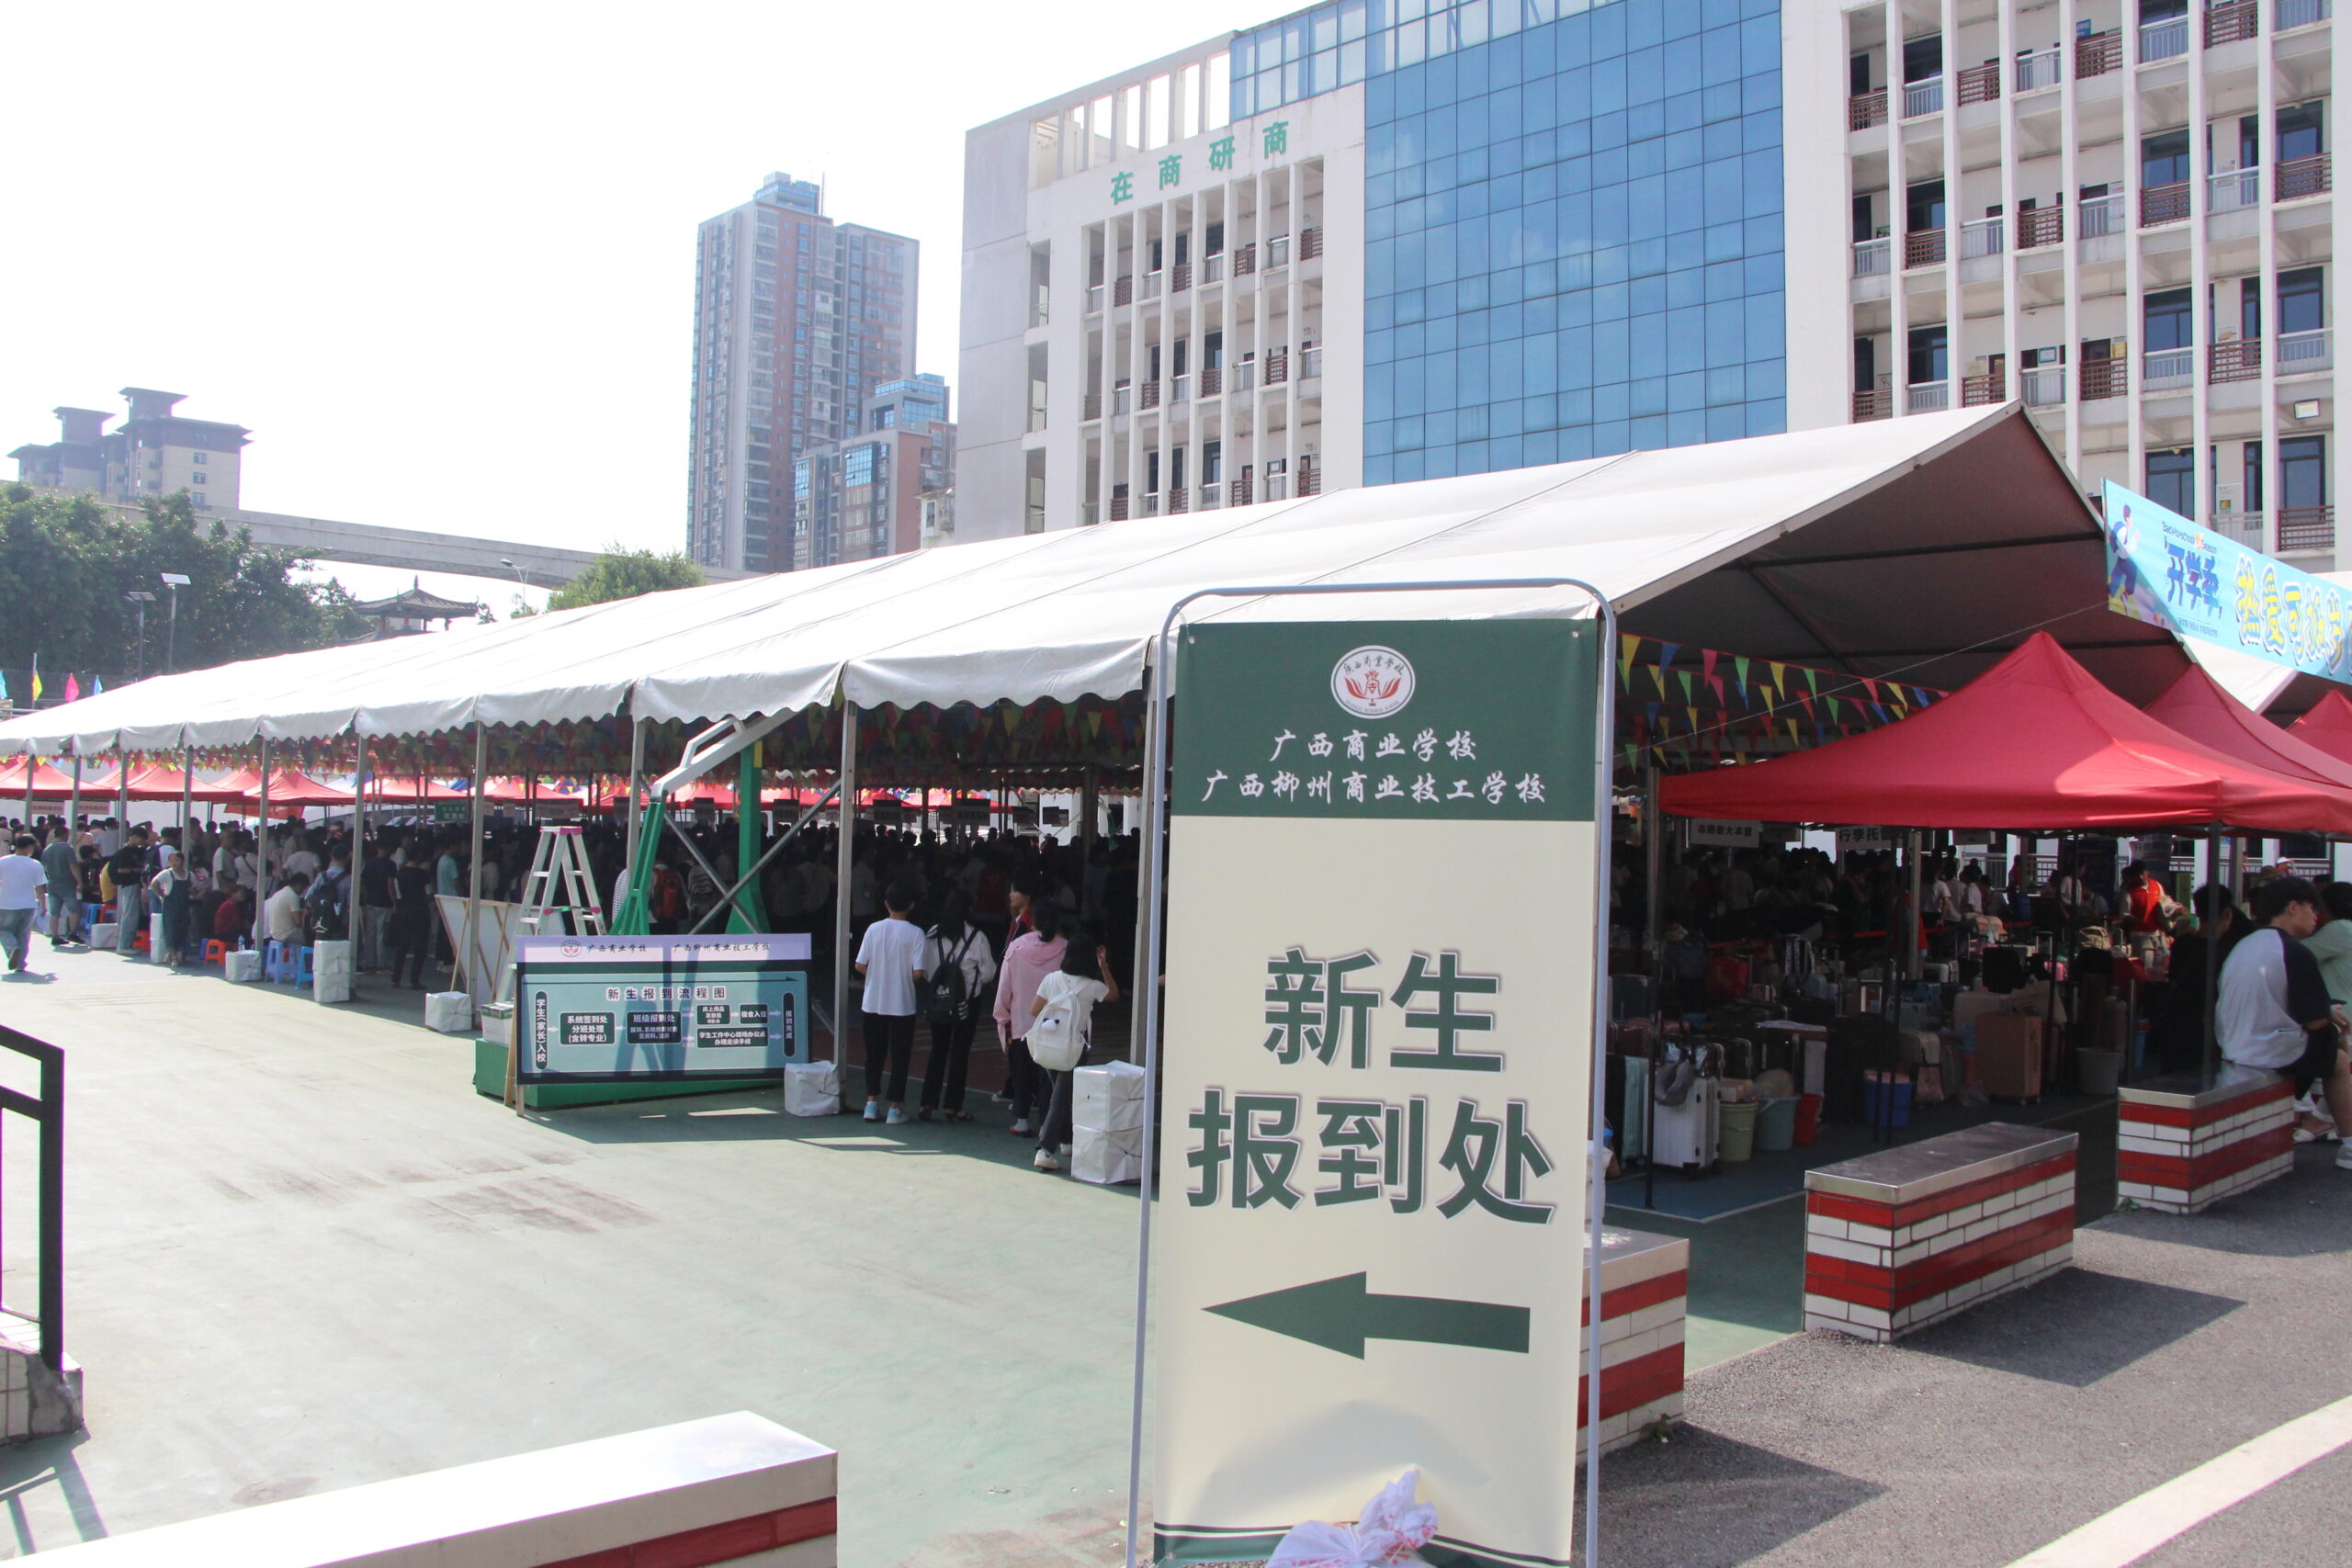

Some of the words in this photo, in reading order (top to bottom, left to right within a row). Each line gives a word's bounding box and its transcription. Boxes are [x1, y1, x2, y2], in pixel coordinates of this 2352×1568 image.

[1110, 120, 1289, 205] 在商研商
[2166, 542, 2220, 617] 开学季
[2235, 553, 2352, 676] 热爱可抵岁
[1269, 728, 1477, 761] 广西商业学校
[1202, 770, 1547, 805] 广西柳州商业技工学校
[1838, 827, 1879, 842] 行李托
[587, 943, 647, 953] 广西商业学校
[607, 987, 726, 1000] 新生报到流程图
[1262, 945, 1505, 1072] 新生
[568, 1015, 607, 1024] 系统签到处
[571, 1025, 605, 1033] 分班处理
[633, 1014, 675, 1022] 班级报到处
[1186, 1087, 1556, 1225] 报到处
